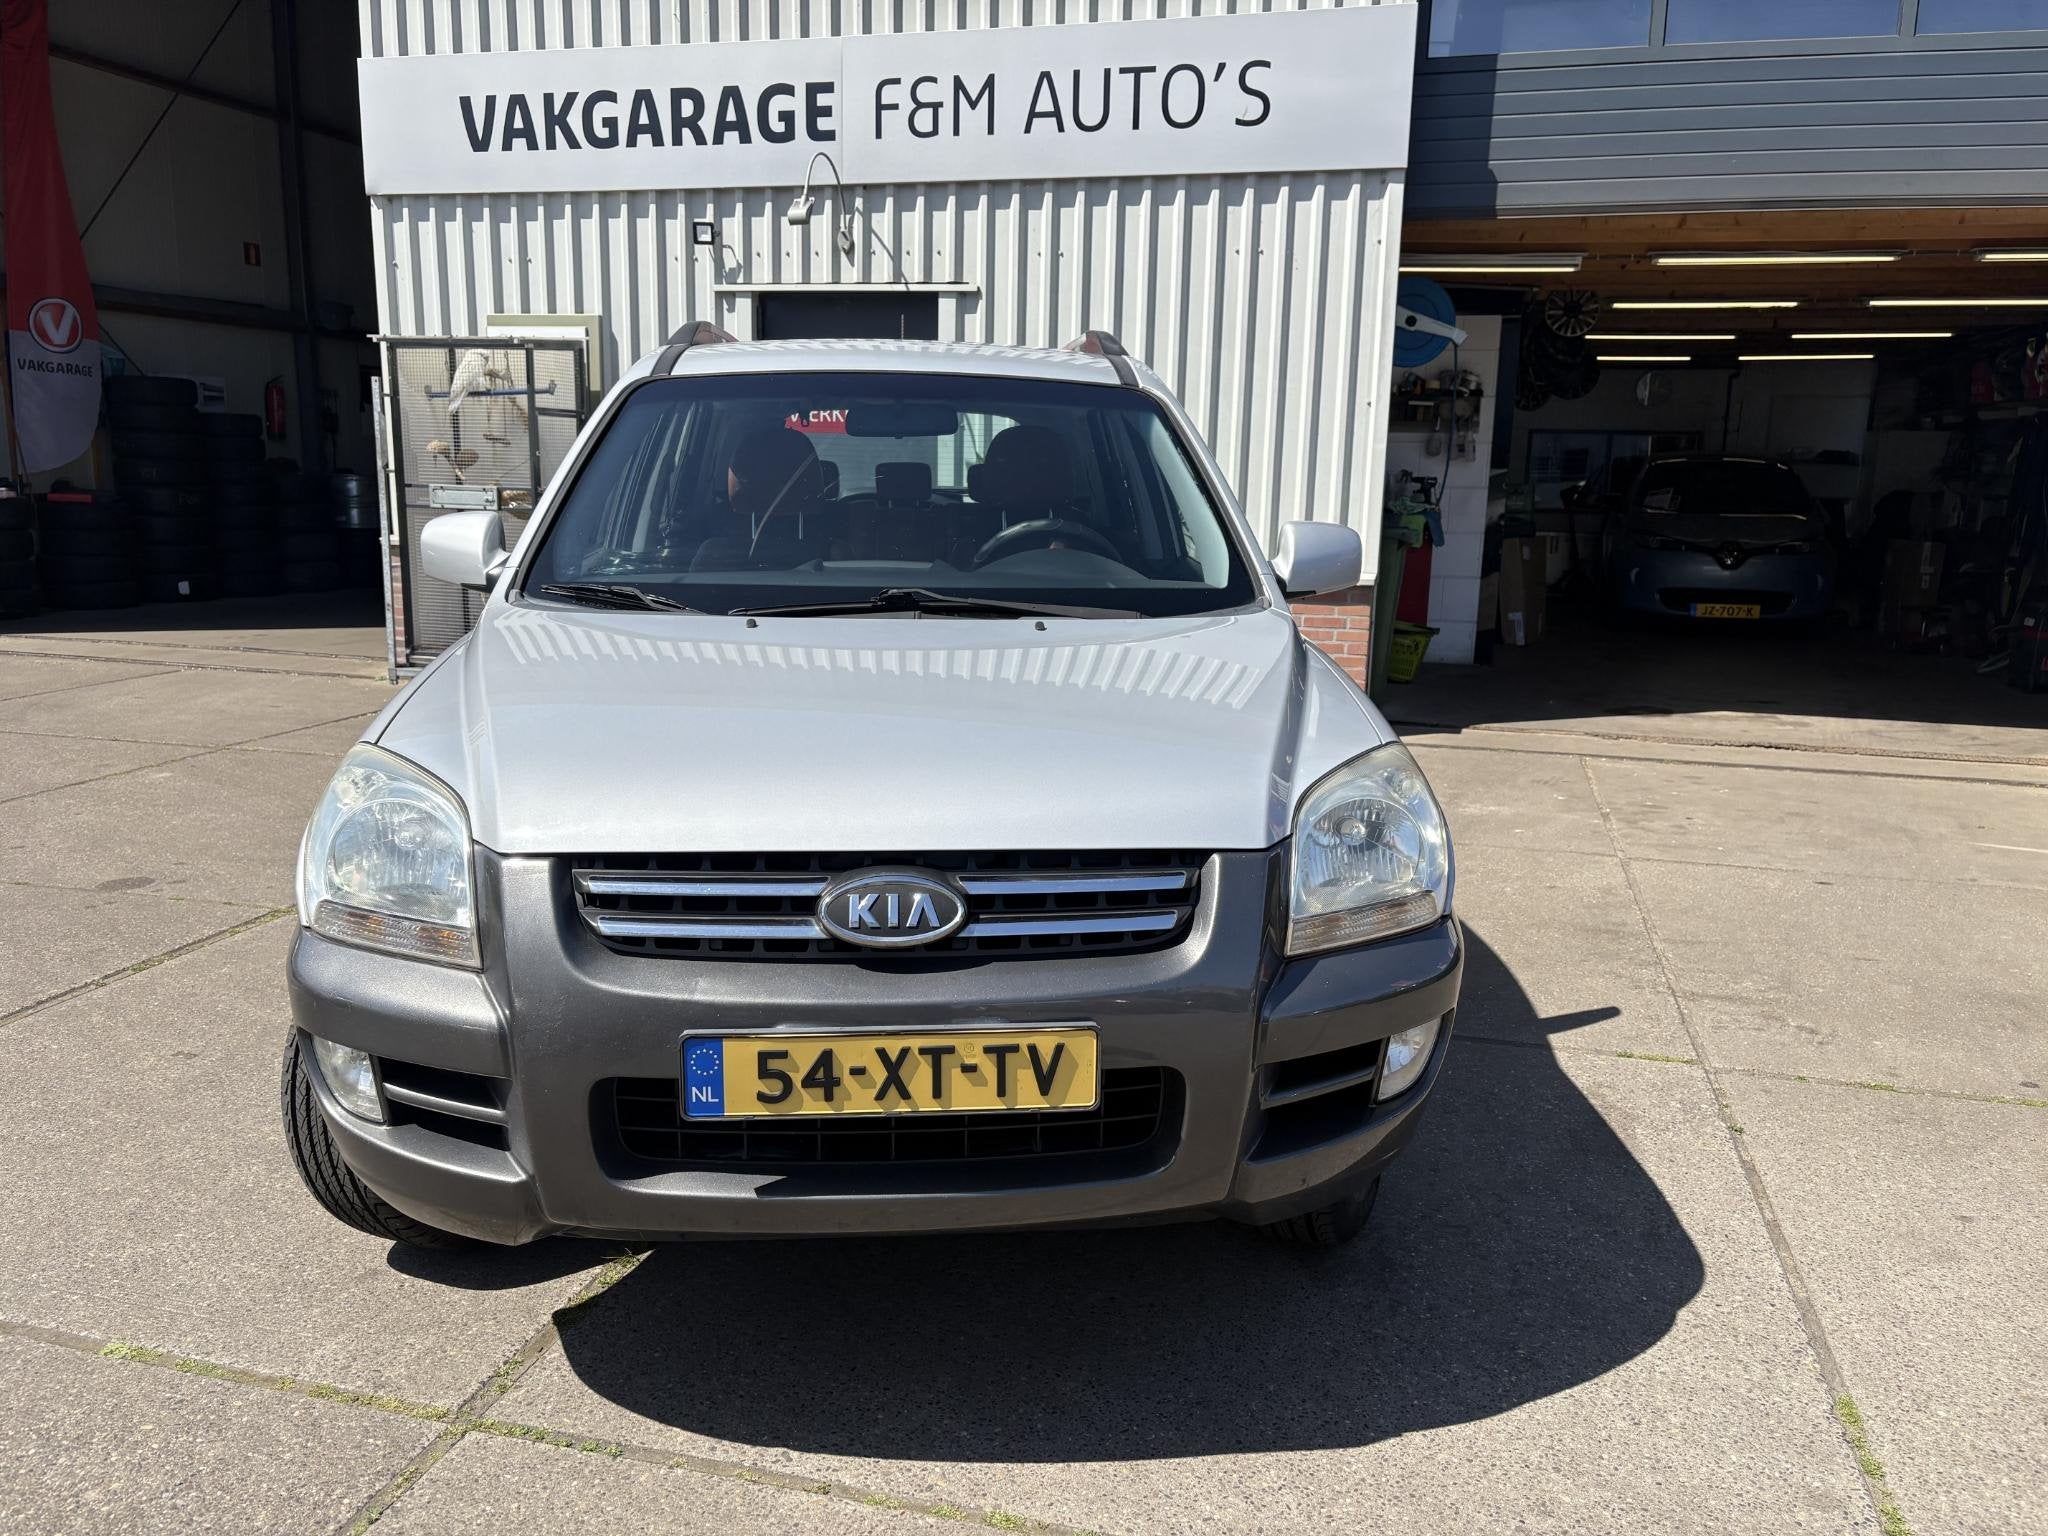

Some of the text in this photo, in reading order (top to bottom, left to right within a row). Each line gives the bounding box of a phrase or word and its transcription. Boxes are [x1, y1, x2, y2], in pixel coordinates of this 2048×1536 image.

[459, 59, 1272, 152] VAKGARAGE F&M AUTO'S
[17, 358, 93, 377] VAKGARAGE
[847, 892, 941, 929] KIA
[757, 1043, 1065, 1104] 54-XT-TV
[691, 1086, 719, 1103] NL
